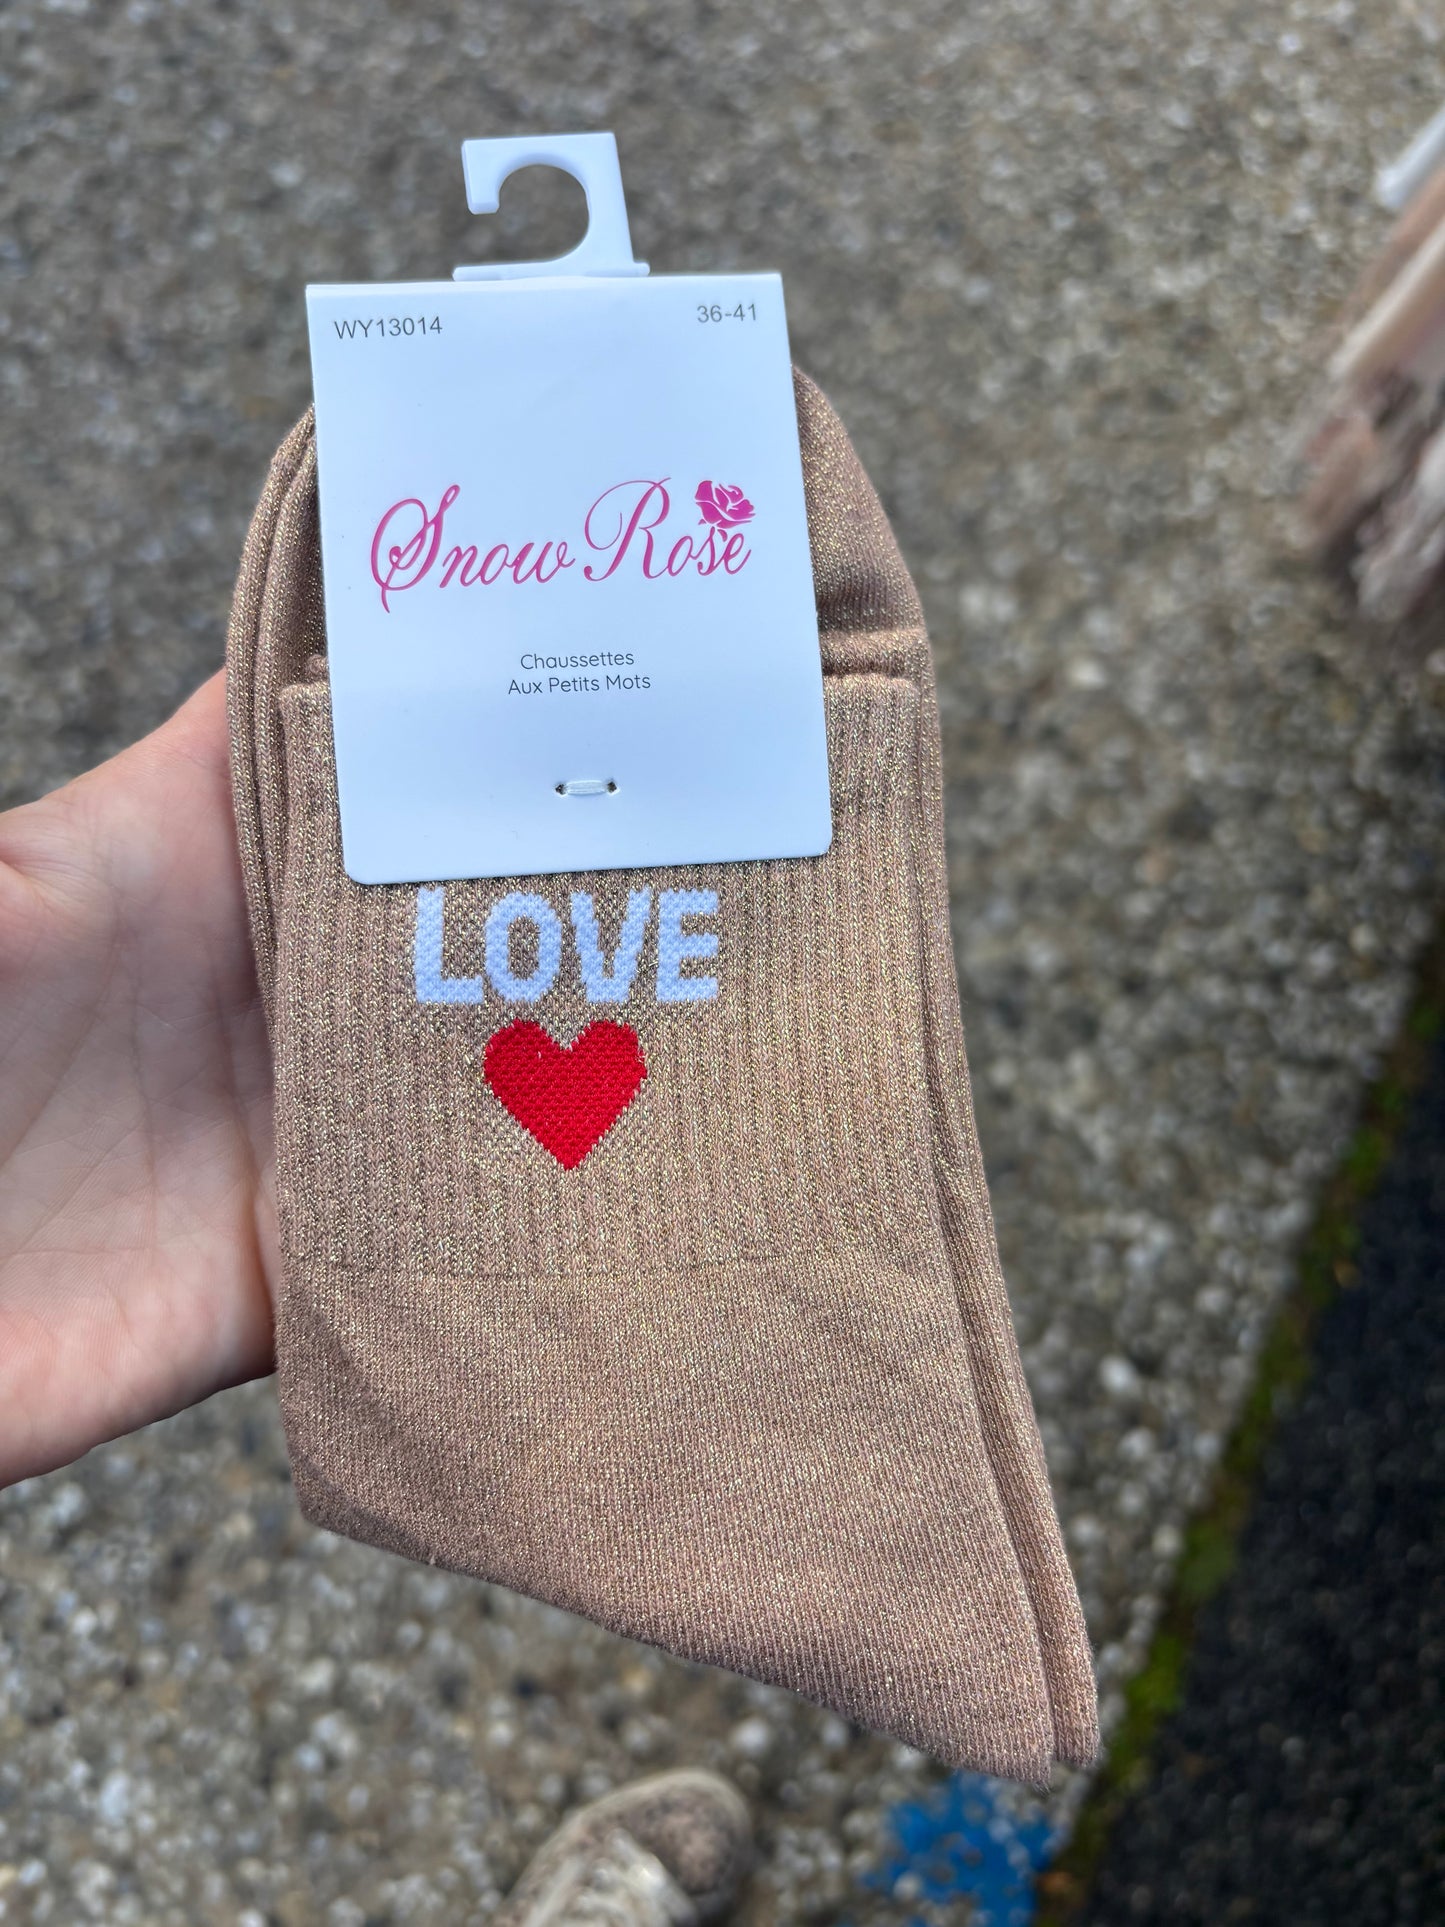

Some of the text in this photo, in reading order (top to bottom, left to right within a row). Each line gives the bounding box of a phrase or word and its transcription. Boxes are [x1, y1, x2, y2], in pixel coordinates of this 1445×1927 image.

[697, 303, 757, 323] 36-41
[335, 316, 443, 340] WY13014
[370, 477, 752, 614] Snow Rose
[520, 650, 635, 670] Chaussettes
[508, 673, 651, 695] Aux Petits Mots
[413, 885, 720, 1004] LOVE
